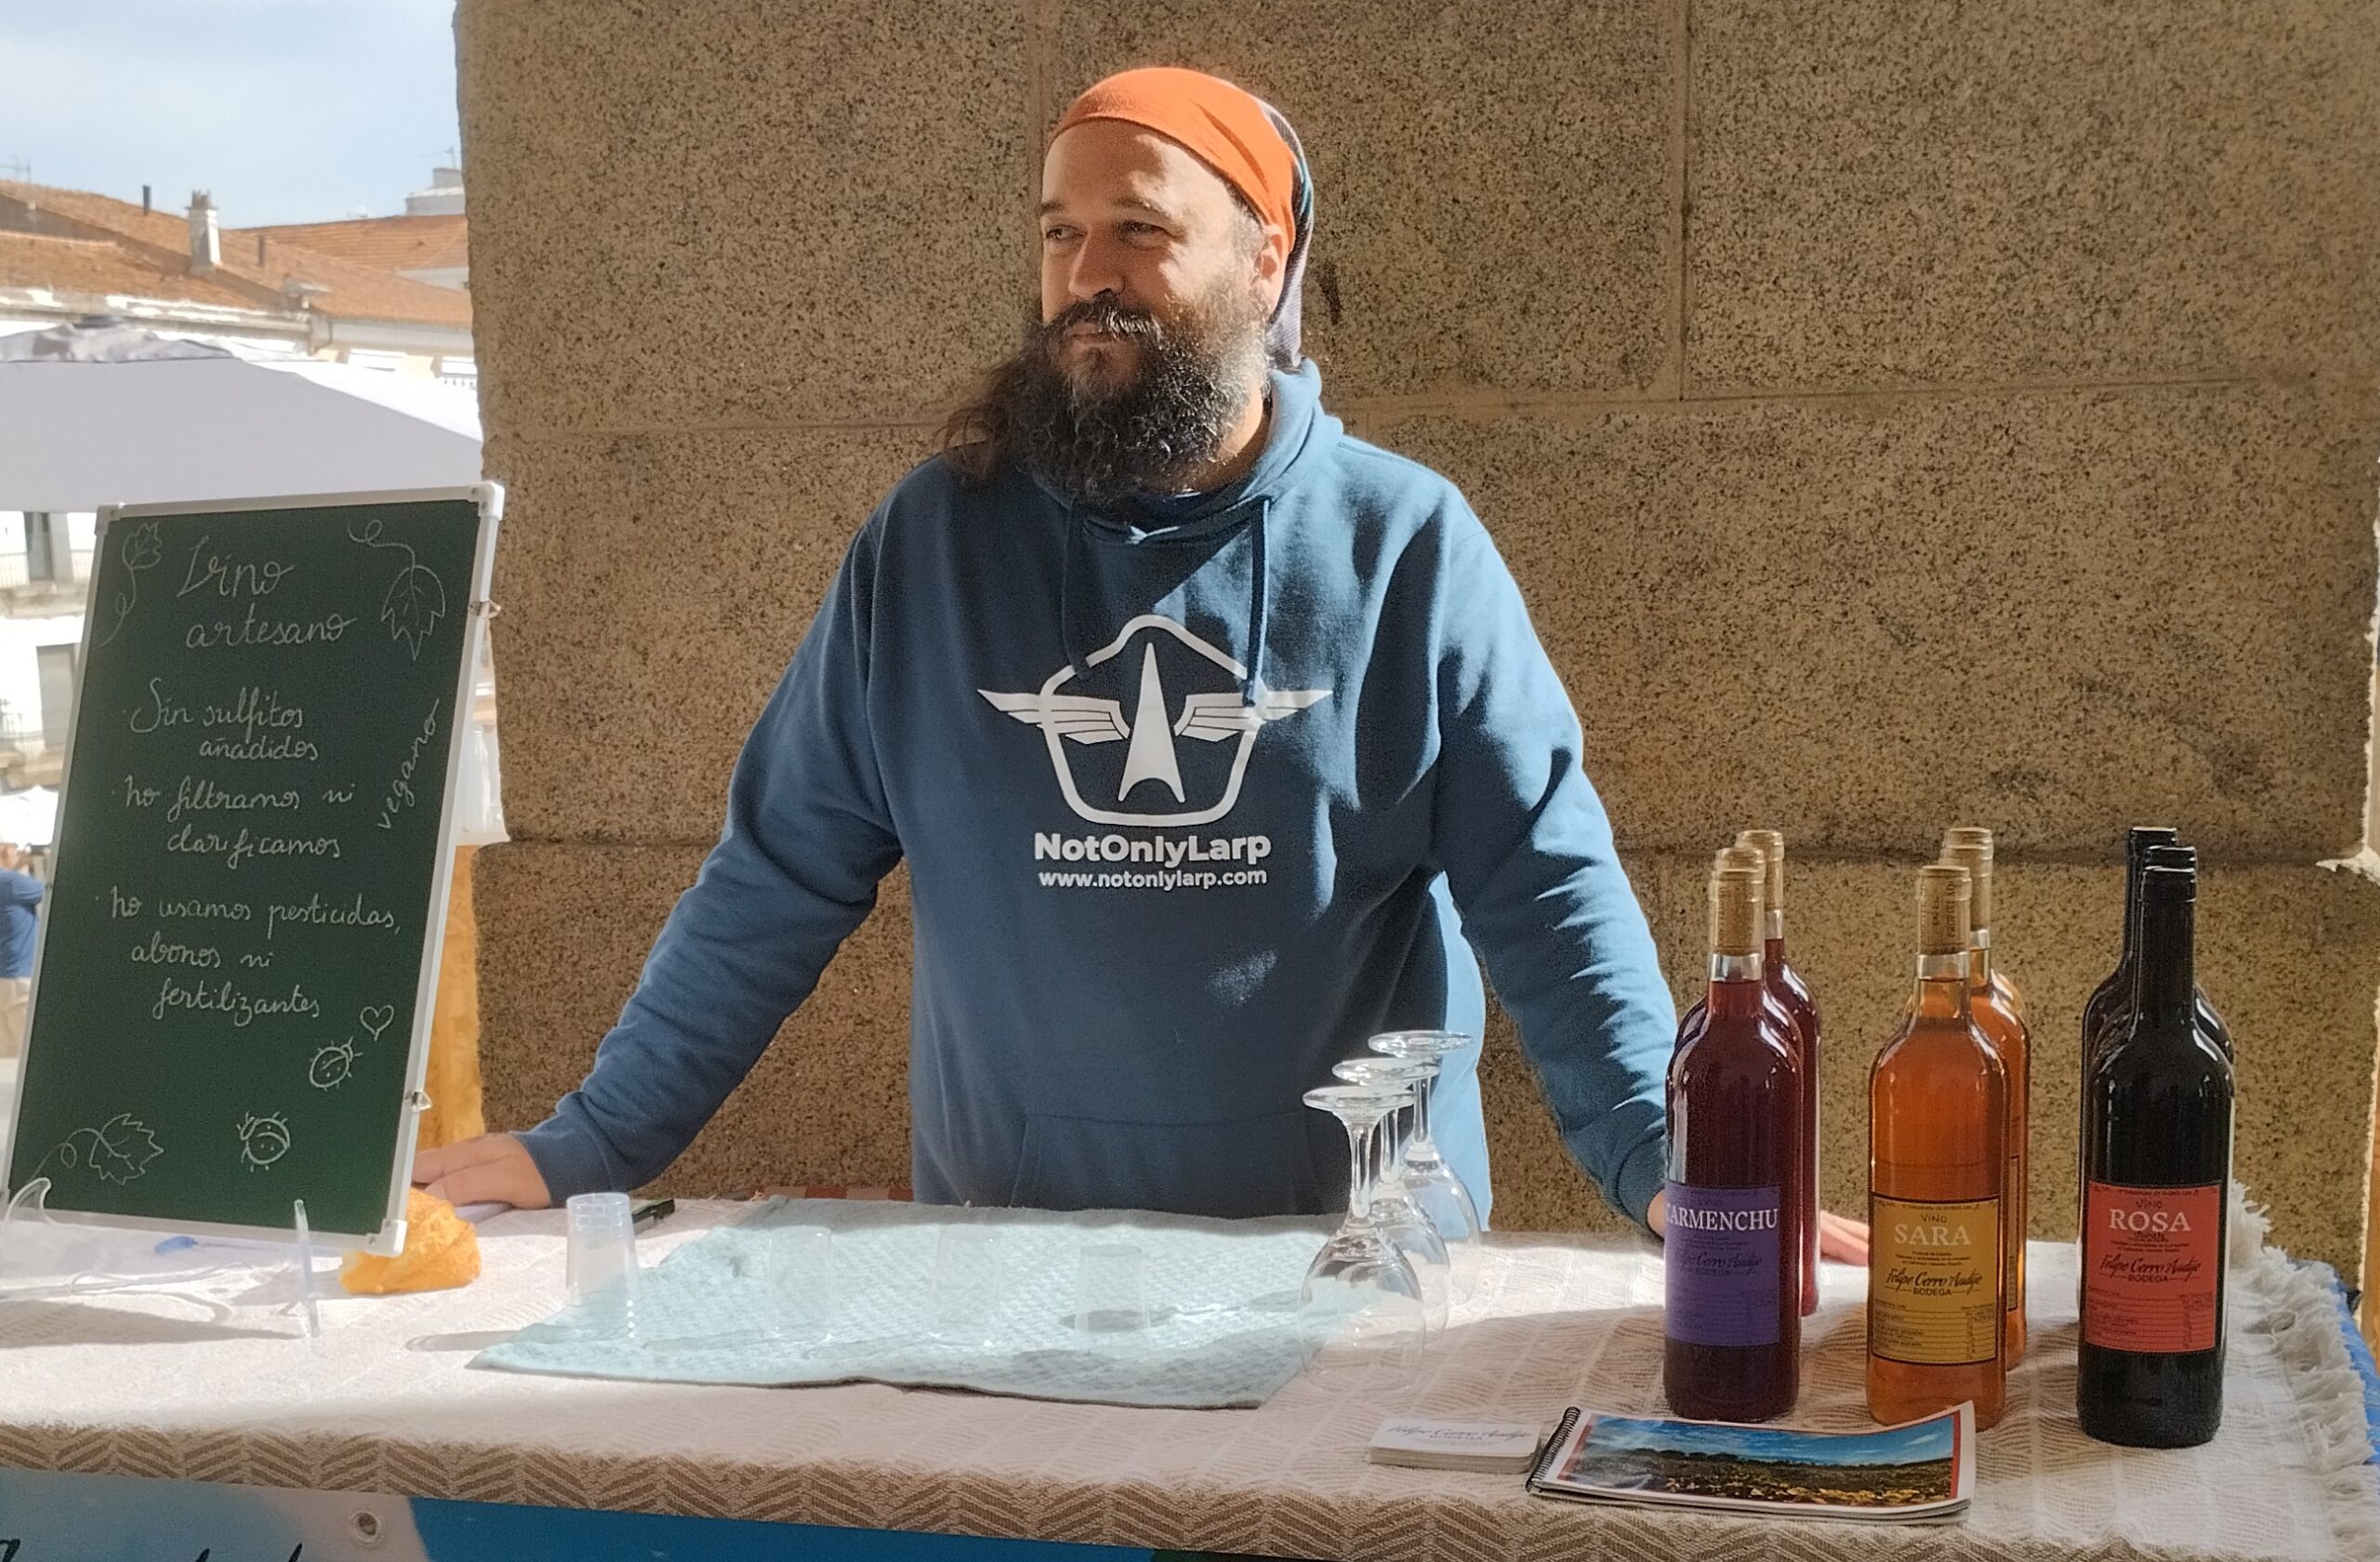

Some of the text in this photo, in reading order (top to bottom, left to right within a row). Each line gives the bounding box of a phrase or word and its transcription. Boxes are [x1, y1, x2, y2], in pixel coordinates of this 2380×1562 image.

[186, 602, 359, 649] artesano
[130, 677, 303, 745] Sin sulfitos
[199, 735, 319, 761] añadidos
[377, 697, 440, 829] vegano
[167, 775, 300, 823] filtramos
[323, 783, 355, 802] ni
[167, 824, 340, 869] clarificamos
[1034, 832, 1272, 867] NotOnlyLarp
[1038, 869, 1268, 891] www.notonlylarp.com
[160, 899, 251, 920] usamos
[269, 893, 401, 940] pesticidas,
[131, 931, 274, 968] abonos ni
[152, 977, 320, 1026] fertilizantes
[1894, 1224, 1972, 1246] SARA
[2109, 1209, 2191, 1232] ROSA
[1913, 1288, 1952, 1296] BODEGA
